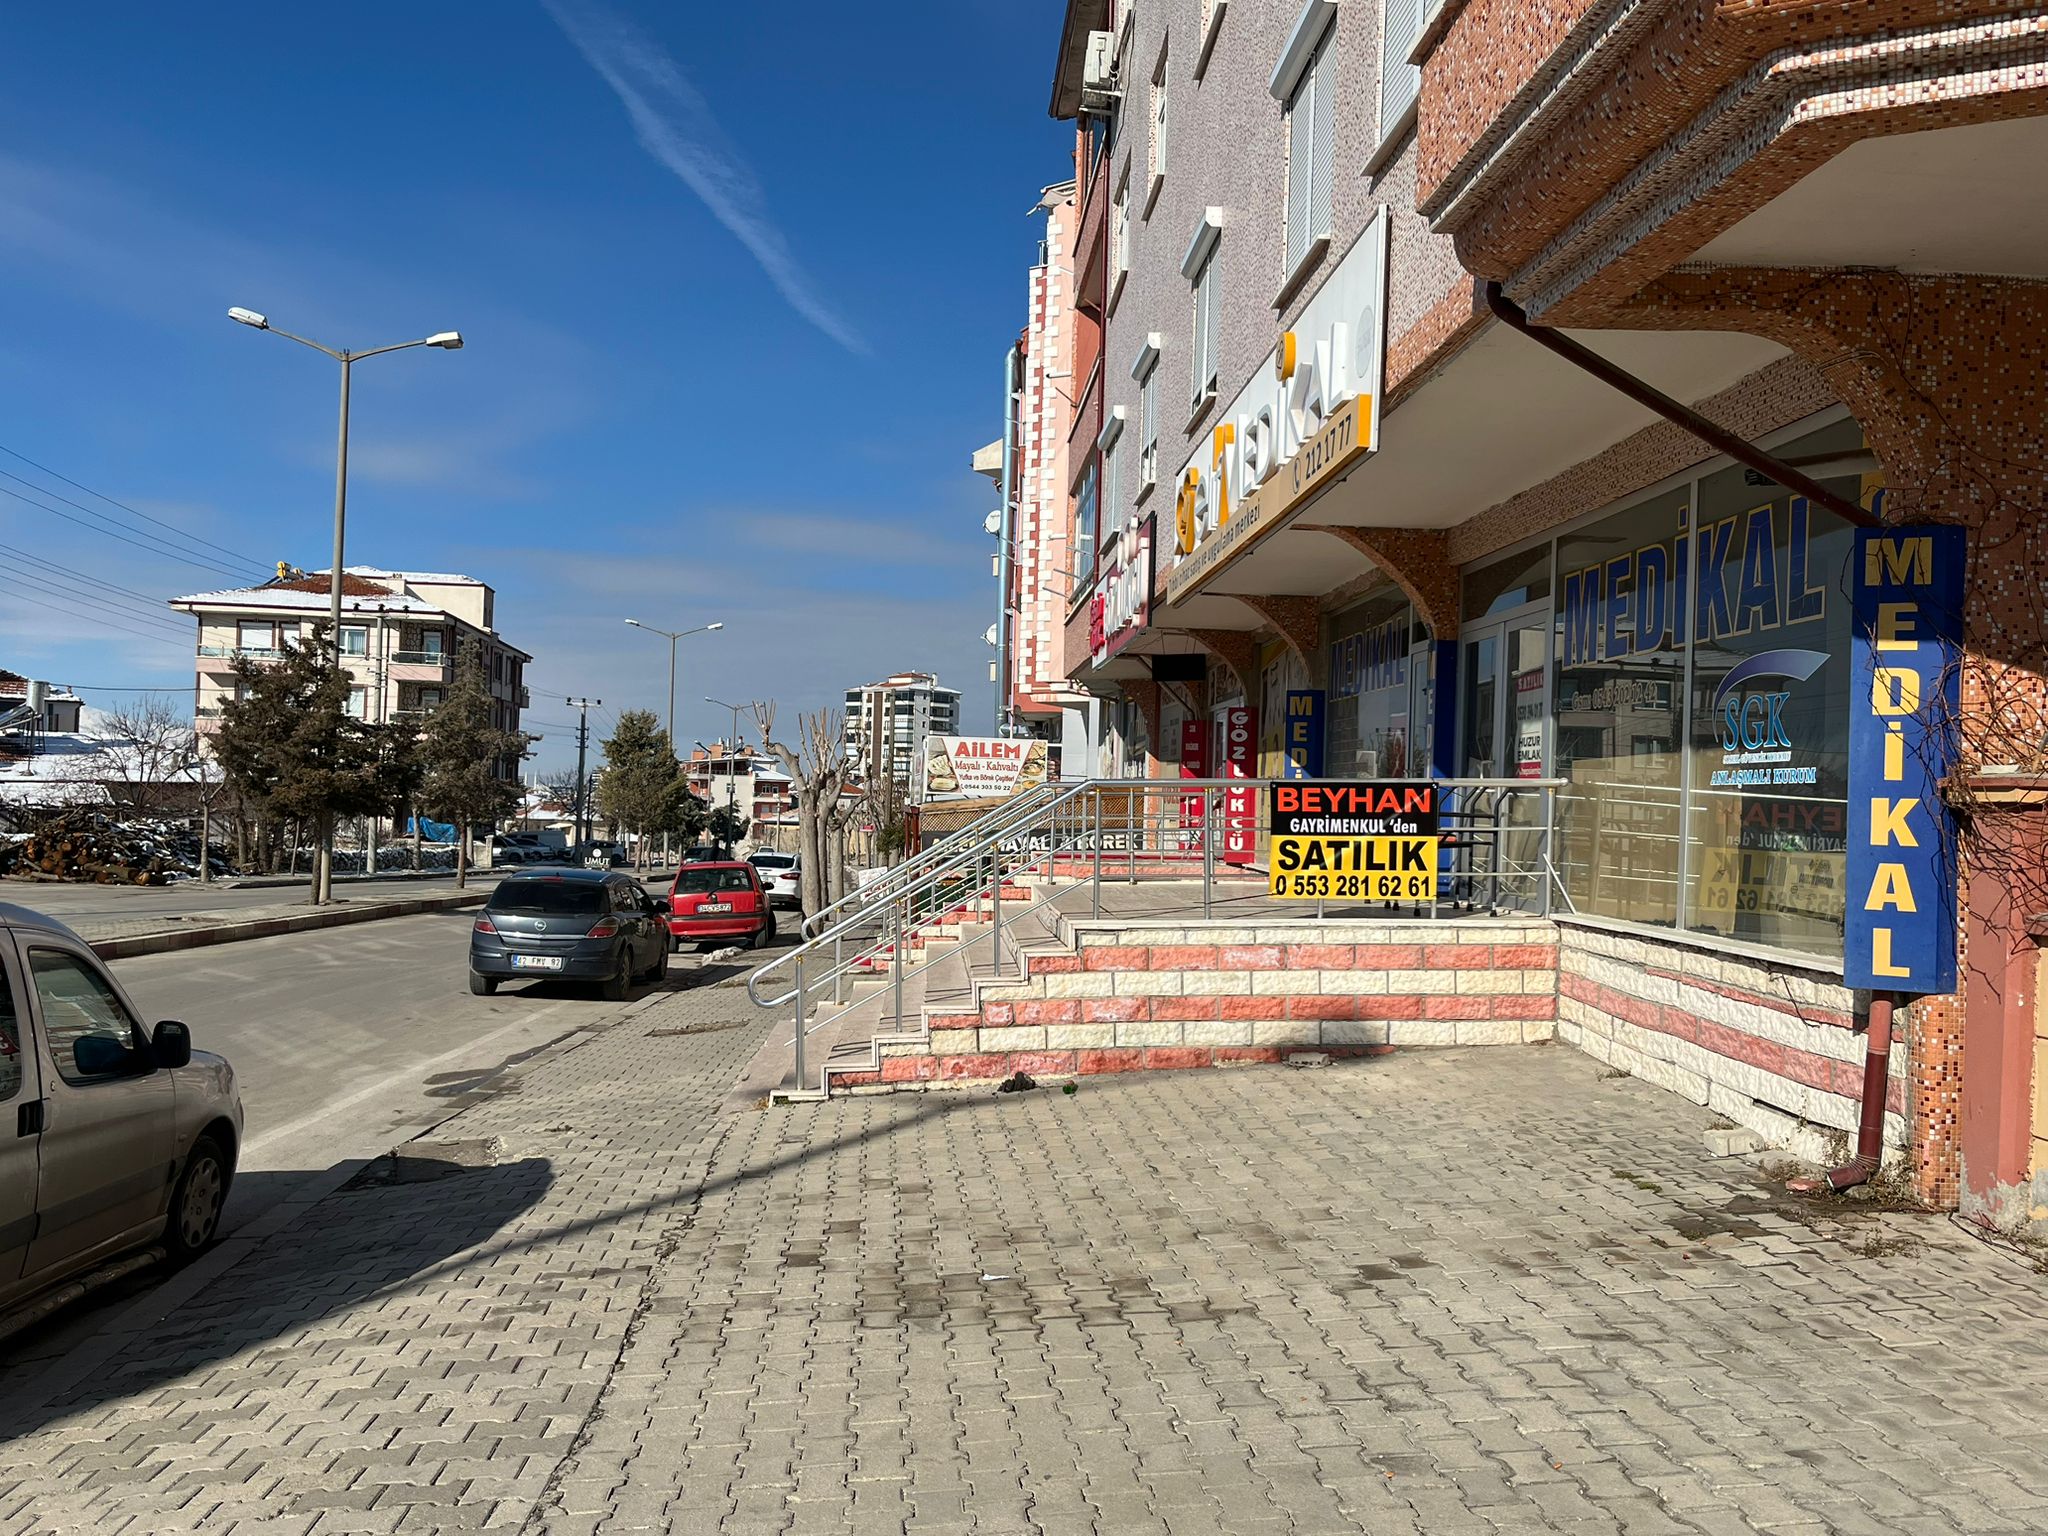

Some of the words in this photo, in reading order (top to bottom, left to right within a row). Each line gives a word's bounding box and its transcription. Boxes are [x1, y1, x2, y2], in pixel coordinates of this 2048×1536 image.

[1306, 442, 1322, 480] 212
[1325, 427, 1336, 463] 17
[1339, 414, 1351, 451] 77
[1235, 495, 1260, 538] merkezi
[1562, 494, 1826, 671] MEDİKAL
[1723, 692, 1791, 751] SGK
[955, 761, 980, 772] Mayalı
[986, 761, 1019, 772] Kahvaltı
[1864, 537, 1933, 978] MEDİKAL
[1710, 769, 1771, 789] ANLAŞMALI
[1773, 767, 1817, 784] KURUM
[1277, 787, 1431, 813] BEYHAN
[1290, 814, 1386, 833] GAYRİMENKUL
[584, 856, 610, 866] UMUT
[1277, 839, 1428, 872] SATILIK
[1275, 874, 1288, 896] 0
[1293, 874, 1330, 896] 553
[1336, 875, 1370, 896] 281
[1378, 875, 1402, 897] 62
[1408, 875, 1430, 897] 61
